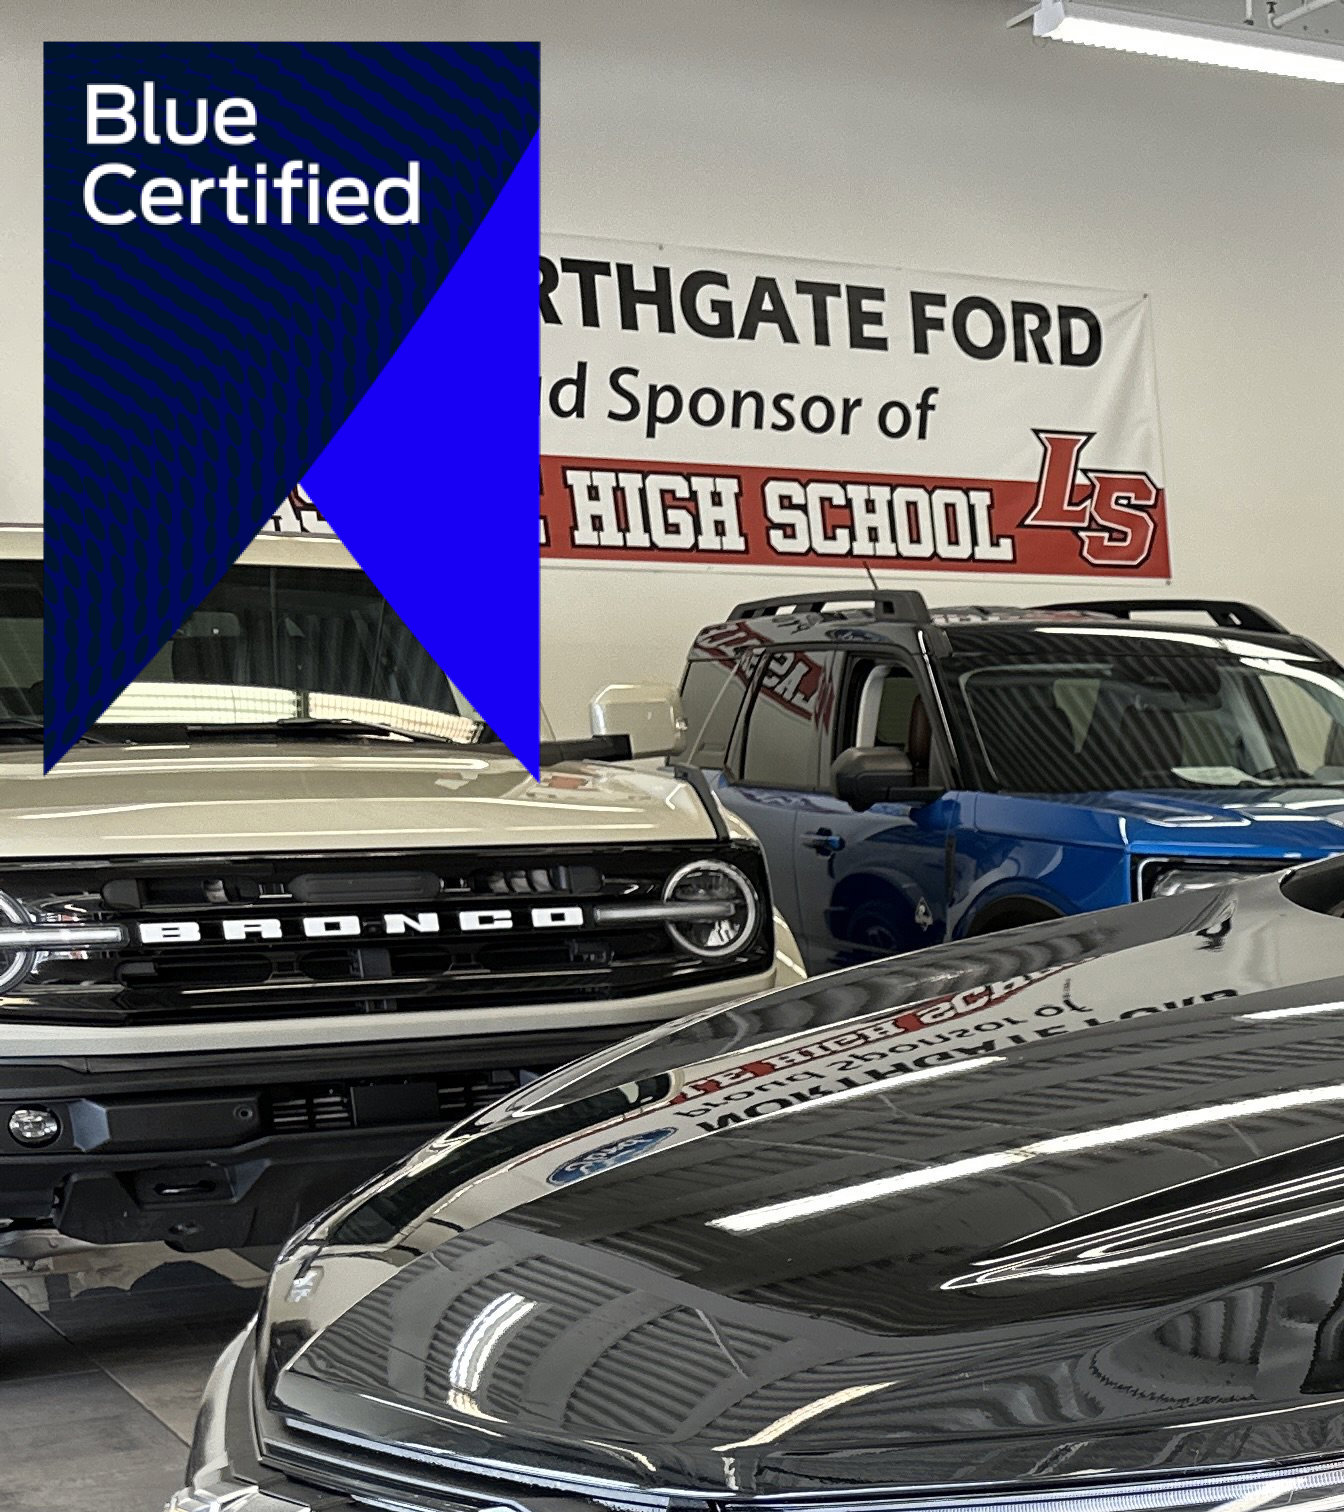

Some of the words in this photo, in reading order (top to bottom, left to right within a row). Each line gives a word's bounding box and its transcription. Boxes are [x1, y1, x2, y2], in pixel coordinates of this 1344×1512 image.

[539, 255, 889, 351] RTHGATE
[910, 290, 1103, 368] FORD
[607, 366, 863, 438] Sponsor
[877, 387, 939, 441] of
[564, 467, 746, 553] HIGH
[763, 478, 1016, 562] SCHOOL
[140, 905, 584, 945] BRONCO
